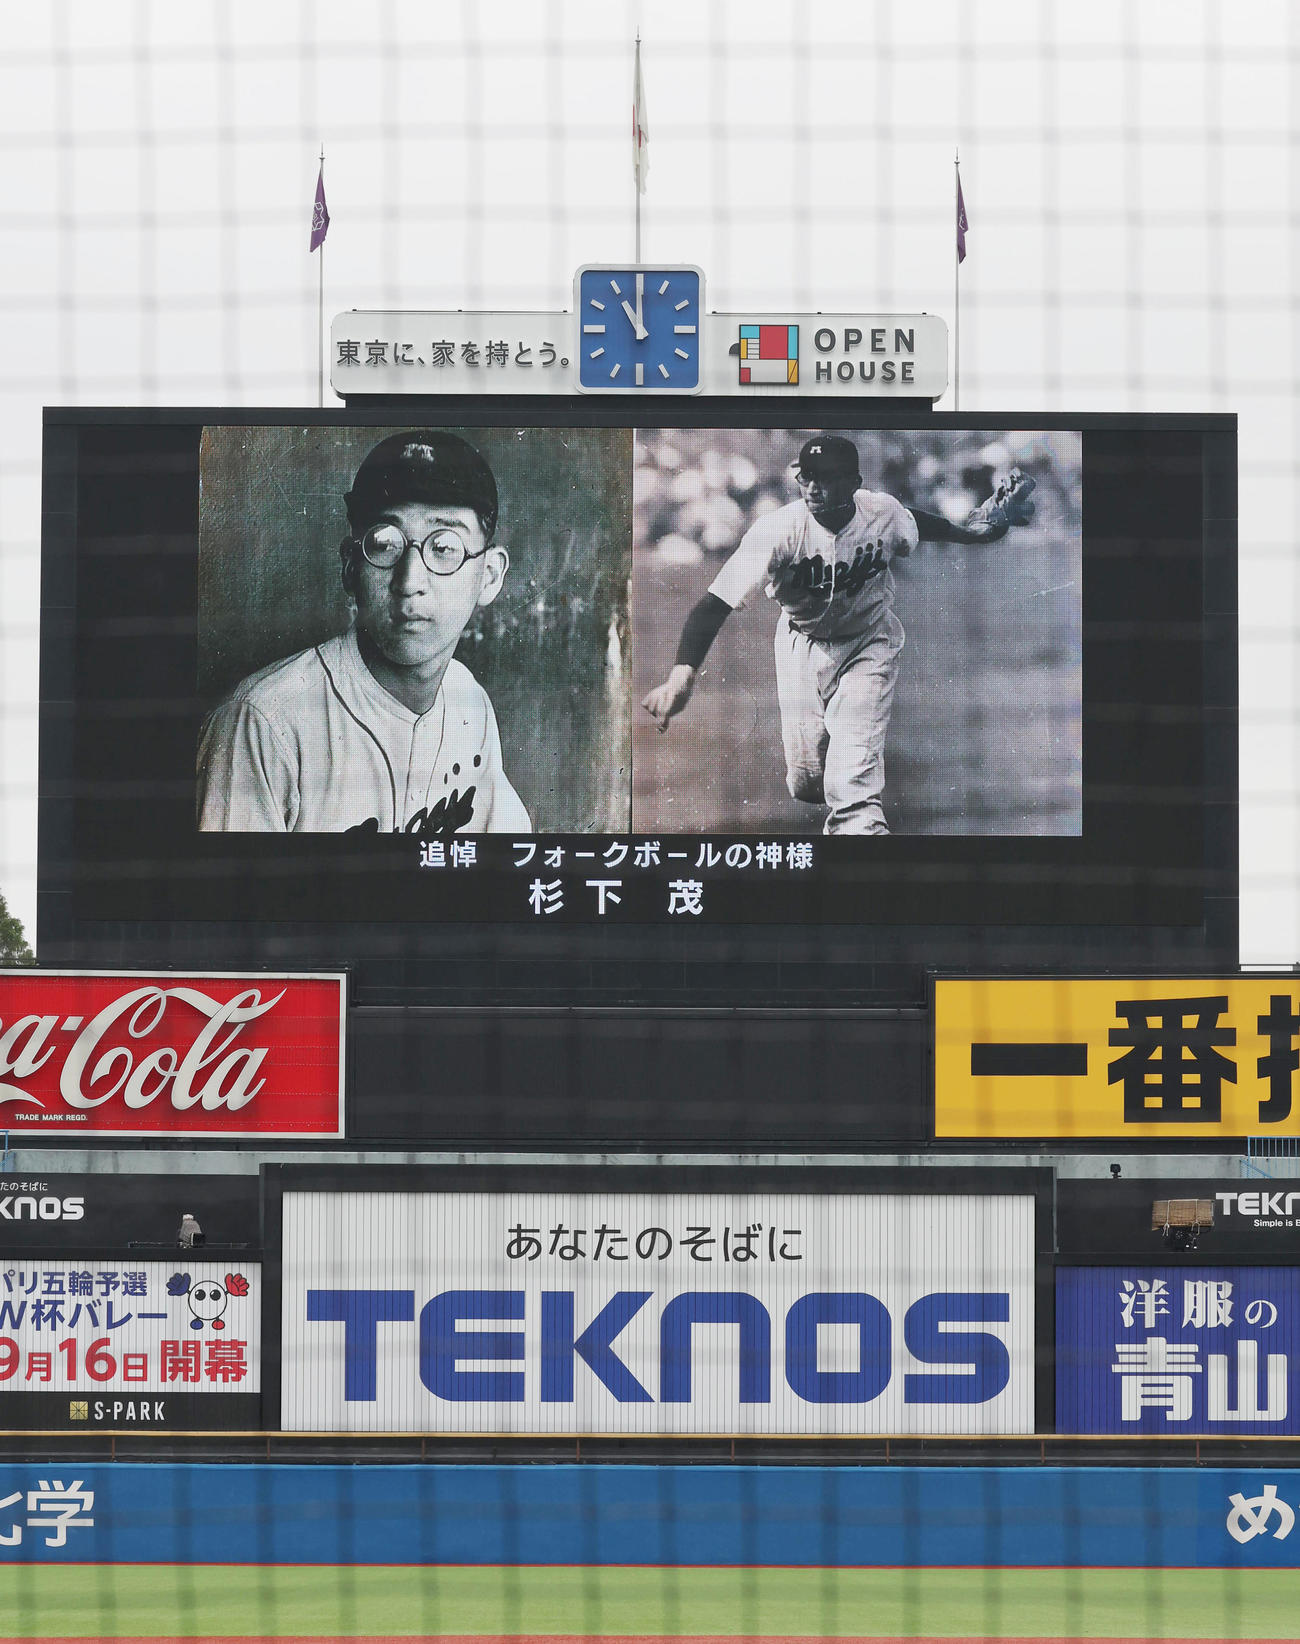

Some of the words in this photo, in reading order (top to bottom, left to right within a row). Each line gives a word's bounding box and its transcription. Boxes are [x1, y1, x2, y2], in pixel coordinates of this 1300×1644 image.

[337, 339, 570, 366] 東京に、家を持とう。
[814, 328, 914, 352] OPEN
[816, 361, 914, 381] HOUSE
[419, 841, 477, 868] 追悼
[512, 841, 814, 869] フォークボールの神様
[0, 986, 288, 1111] a-Cola
[0, 1182, 48, 1191] たのそばに
[1254, 1219, 1284, 1228] Simple
[1286, 1219, 1293, 1227] is
[506, 1223, 803, 1262] あなたのそばに
[1118, 1278, 1278, 1329] 洋服の
[307, 1290, 1010, 1404] TEKNOS
[1111, 1337, 1288, 1421] 青山
[94, 1401, 165, 1420] S-PARK
[1226, 1485, 1300, 1544] め
